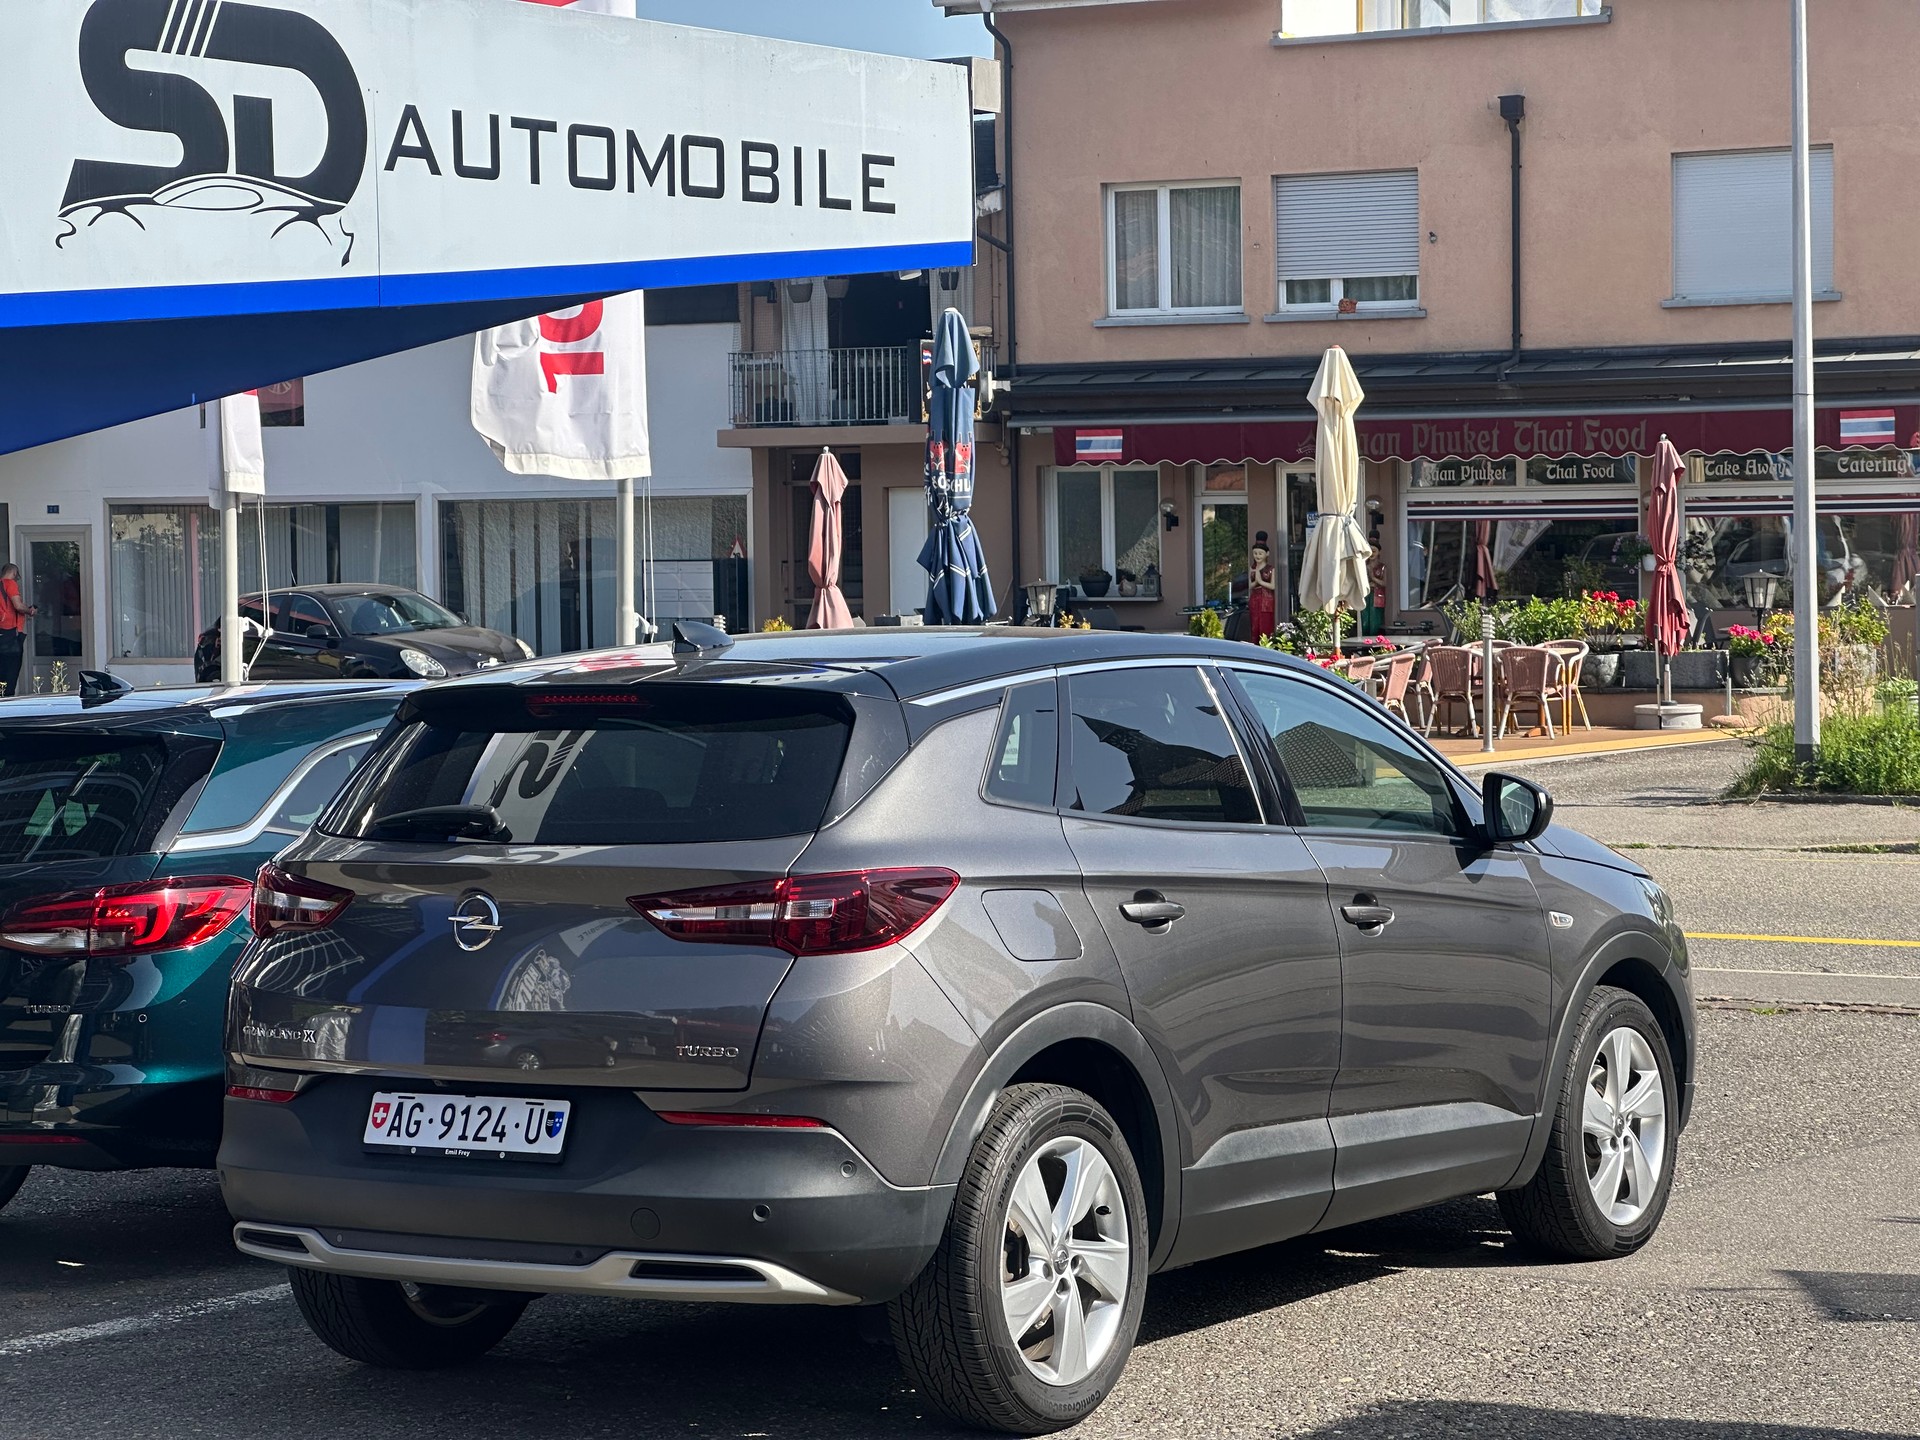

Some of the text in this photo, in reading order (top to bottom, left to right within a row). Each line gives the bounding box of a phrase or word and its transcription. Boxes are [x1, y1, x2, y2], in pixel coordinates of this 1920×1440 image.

[58, 0, 897, 216] SD AUTOMOBILE
[1411, 421, 1500, 455] Phuket
[1513, 420, 1573, 453] Thai
[1583, 418, 1647, 451] Food
[1460, 461, 1507, 481] Phuket
[1546, 463, 1578, 480] Thai
[1582, 462, 1615, 480] Food
[1704, 456, 1909, 478] Take Away Catering
[23, 1004, 71, 1014] TURBO
[302, 1029, 317, 1044] X
[676, 1045, 739, 1058] TURBO
[445, 1148, 471, 1158] Emil Frey
